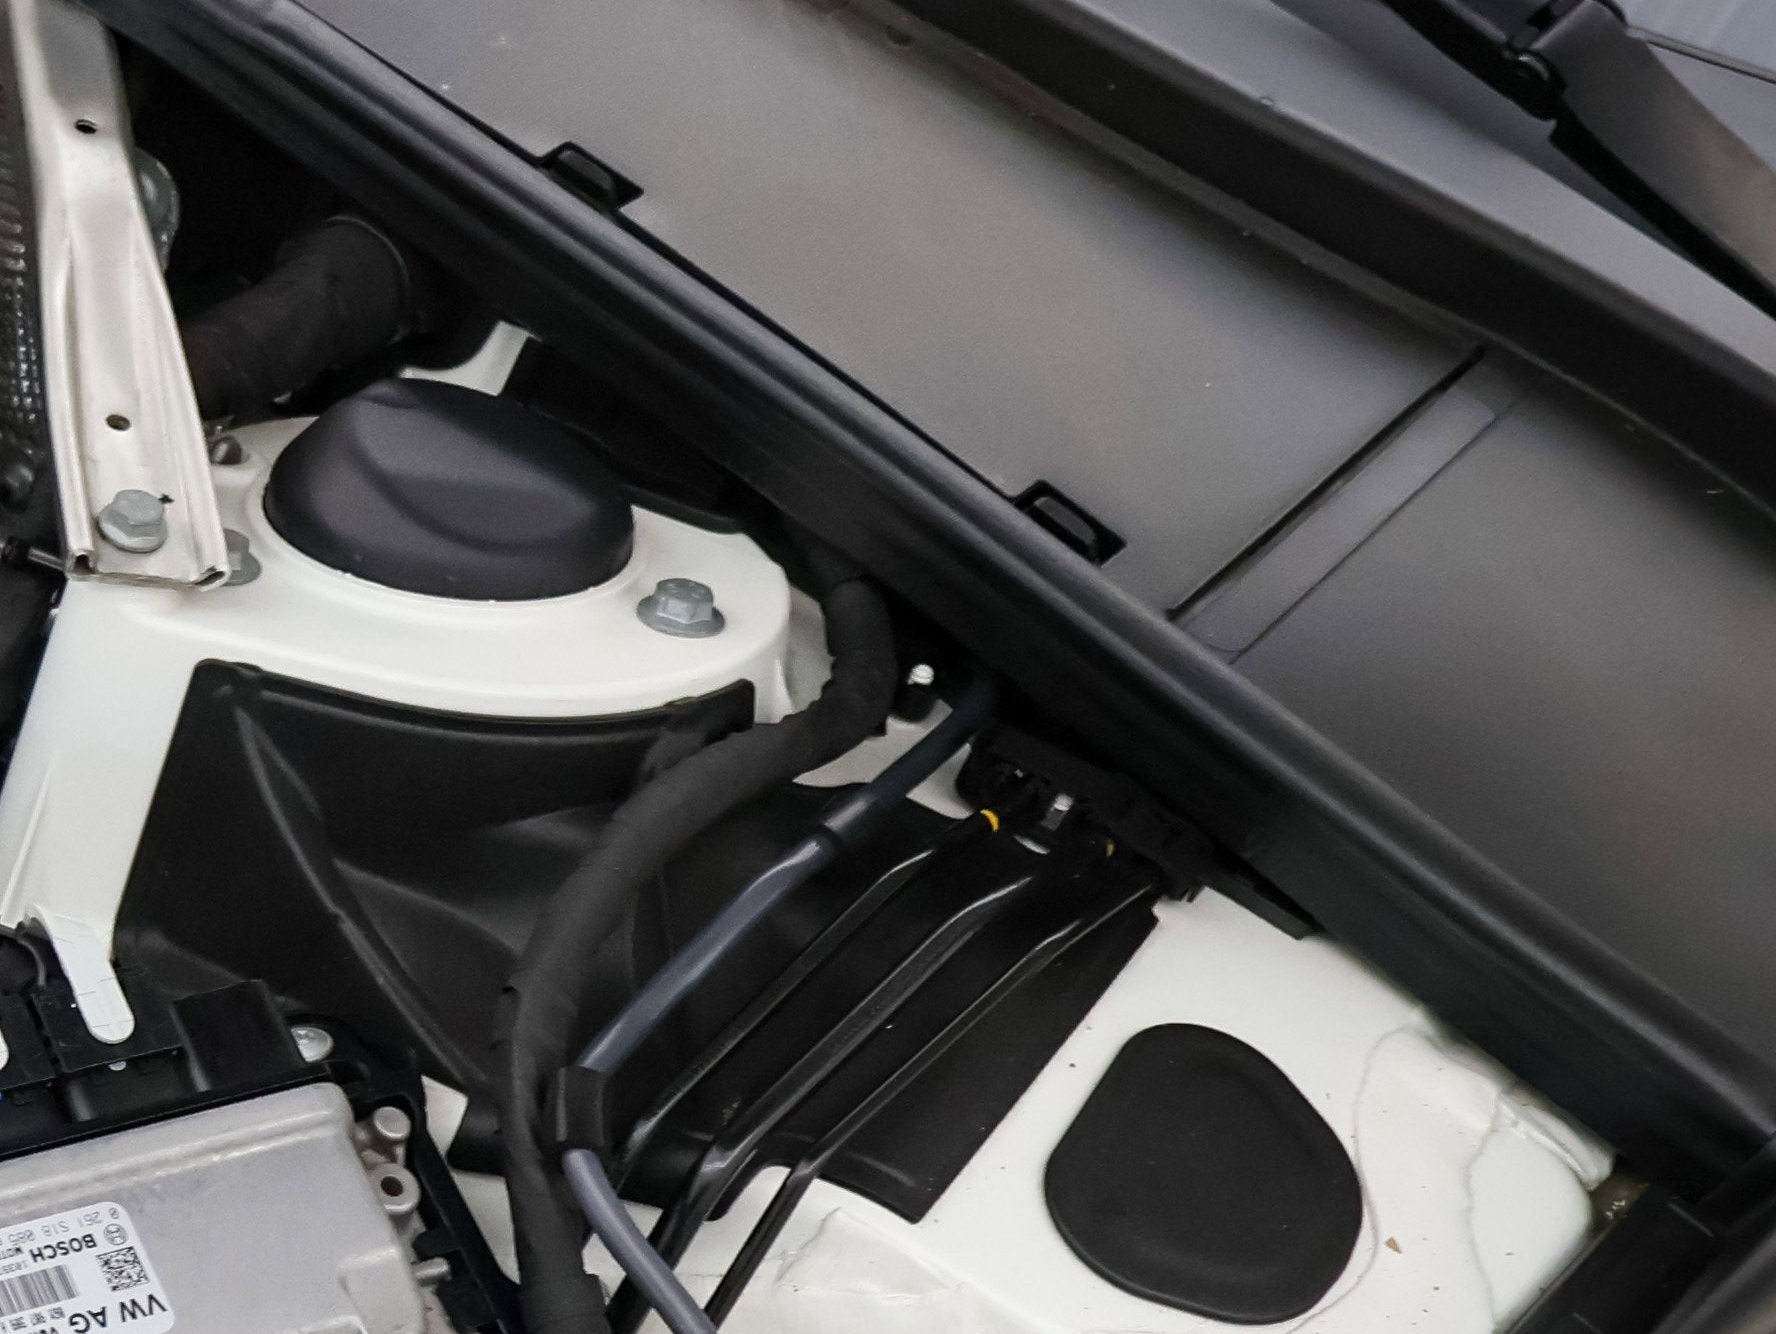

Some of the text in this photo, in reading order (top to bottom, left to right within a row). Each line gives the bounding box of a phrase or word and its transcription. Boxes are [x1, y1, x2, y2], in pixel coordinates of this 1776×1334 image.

[75, 1211, 103, 1227] 261
[27, 1233, 97, 1262] BOSCH
[66, 1292, 166, 1334] VW AG
